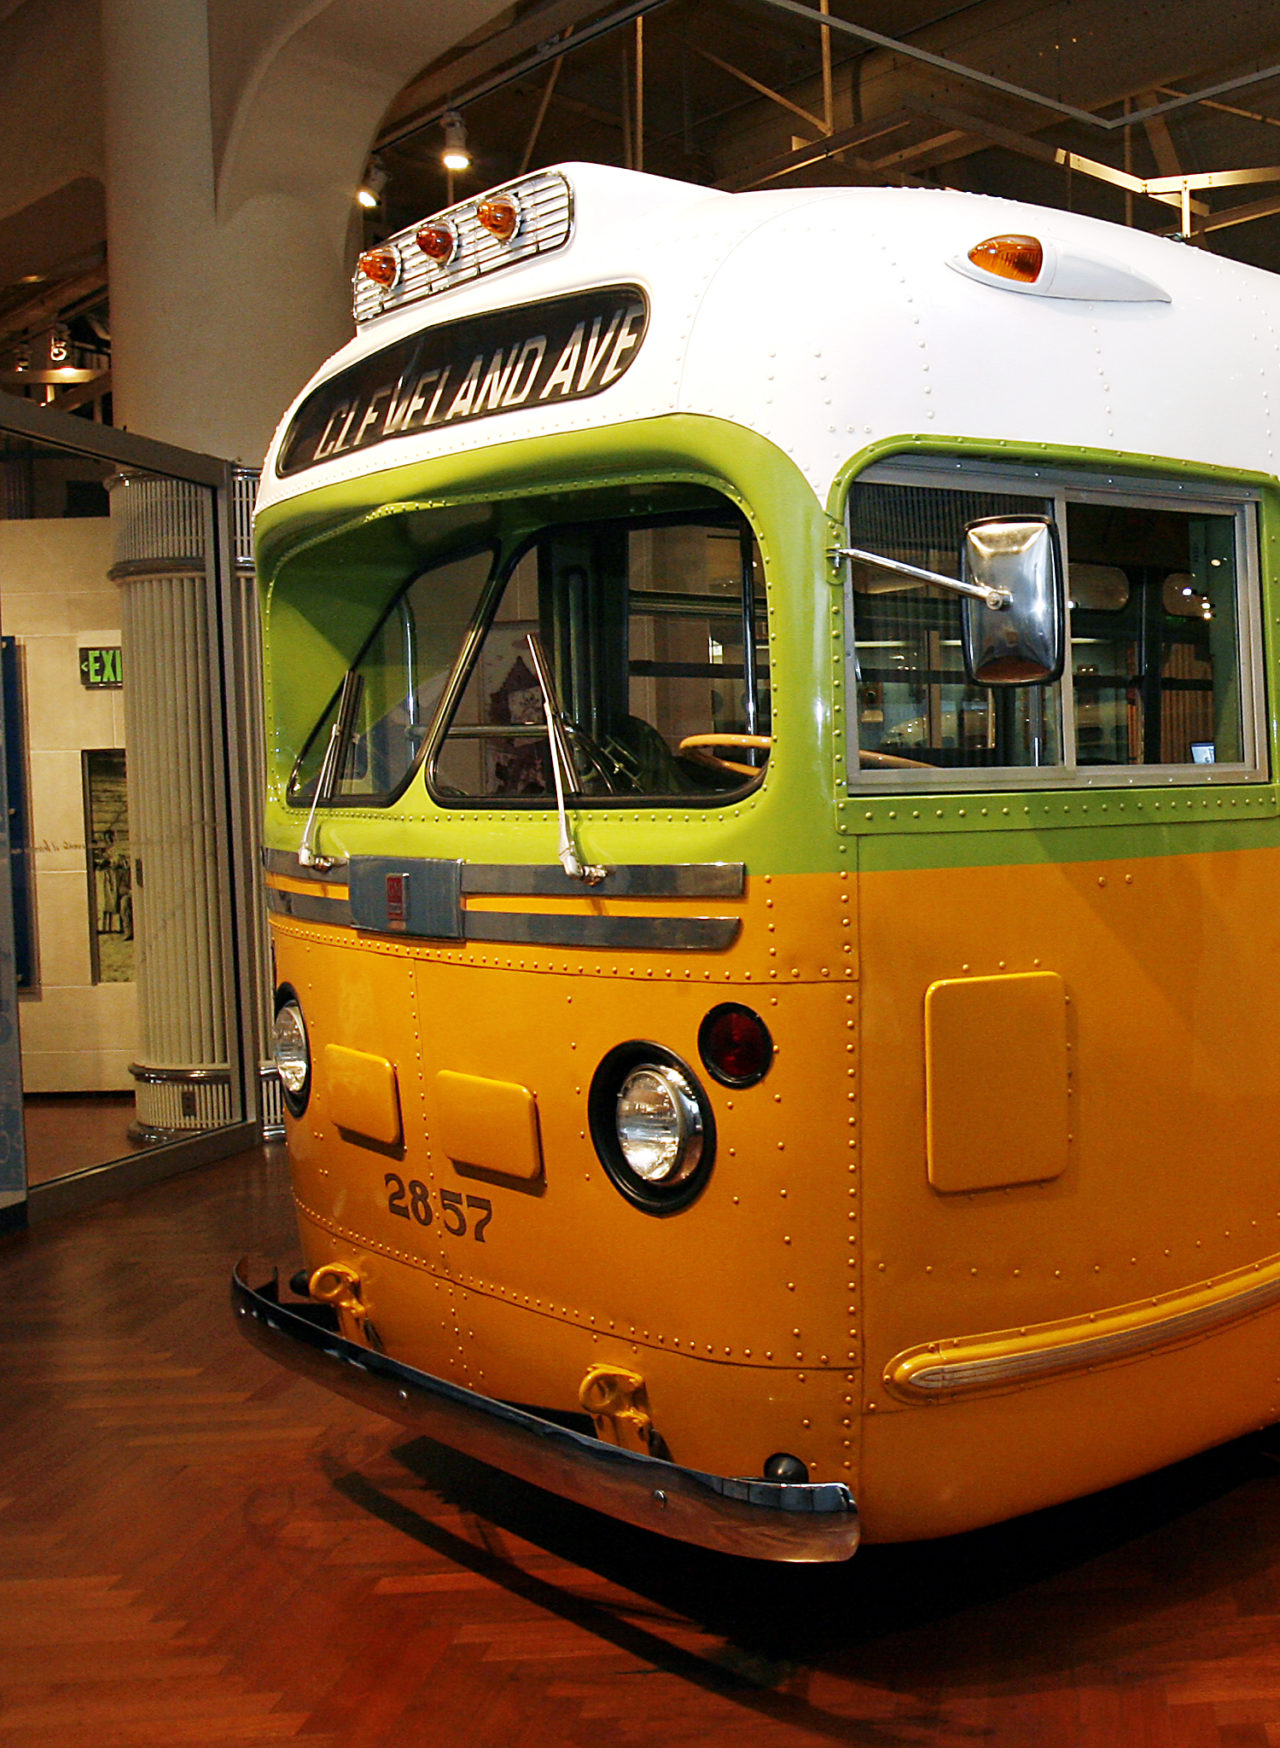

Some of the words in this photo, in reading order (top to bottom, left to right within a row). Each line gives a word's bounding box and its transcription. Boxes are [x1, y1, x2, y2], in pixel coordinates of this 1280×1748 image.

[313, 334, 547, 461] CLEVELAND
[539, 302, 645, 400] AVE
[88, 650, 122, 682] EXI
[384, 1173, 492, 1243] 2857
